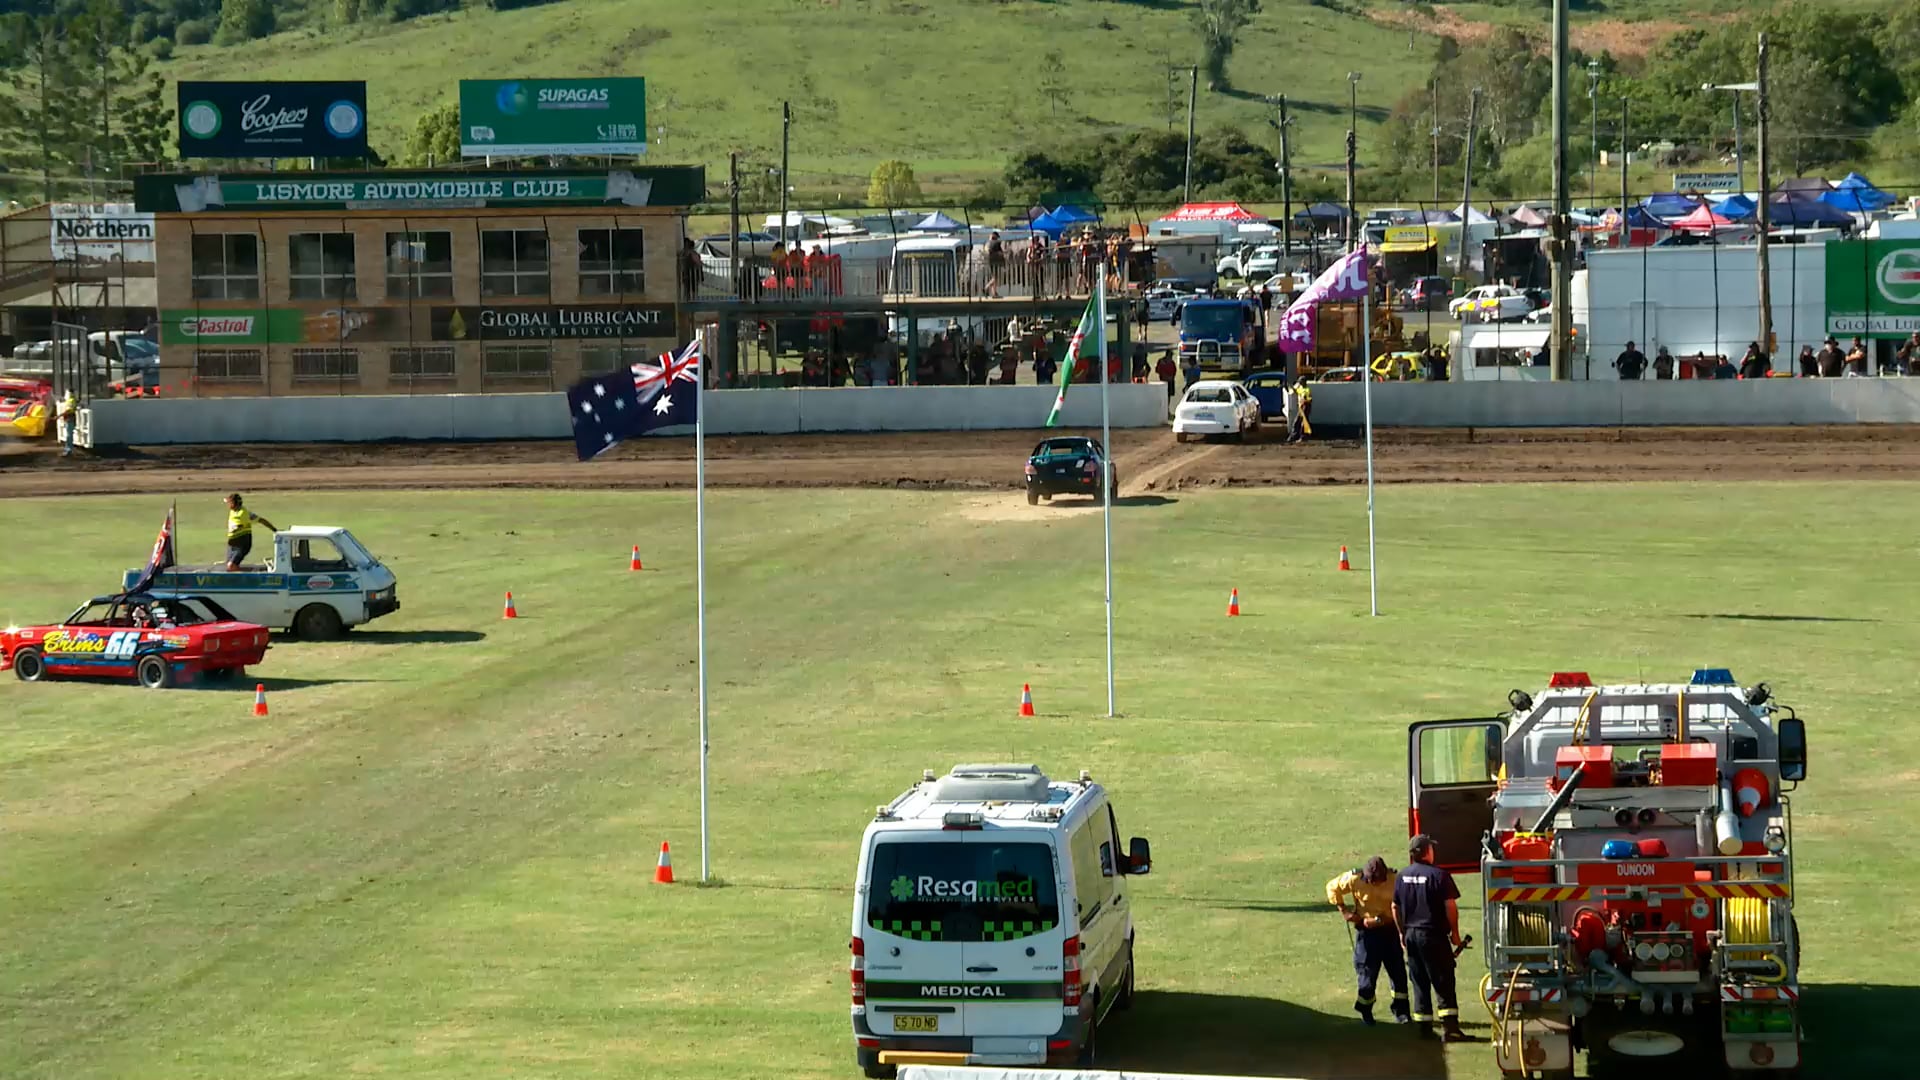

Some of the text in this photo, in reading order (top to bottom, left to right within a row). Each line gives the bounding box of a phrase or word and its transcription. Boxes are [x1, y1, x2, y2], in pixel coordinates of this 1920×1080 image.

[538, 88, 609, 102] SUPAGAS
[241, 94, 308, 134] Coopers
[256, 183, 355, 200] LISMORE
[363, 181, 503, 199] AUTOMOBILE
[513, 180, 570, 197] CLUB
[56, 219, 150, 238] Northern
[198, 319, 248, 333] Castrol
[481, 309, 662, 327] GLOBAL LUBRICANT
[1835, 318, 1888, 330] GLOBAL
[43, 630, 105, 654] Brims
[104, 632, 140, 660] 66
[1617, 863, 1655, 876] DUNOON
[917, 875, 1033, 903] Resqmed
[921, 985, 1006, 997] MEDICAL
[911, 1016, 922, 1028] 70
[924, 1016, 937, 1028] ND
